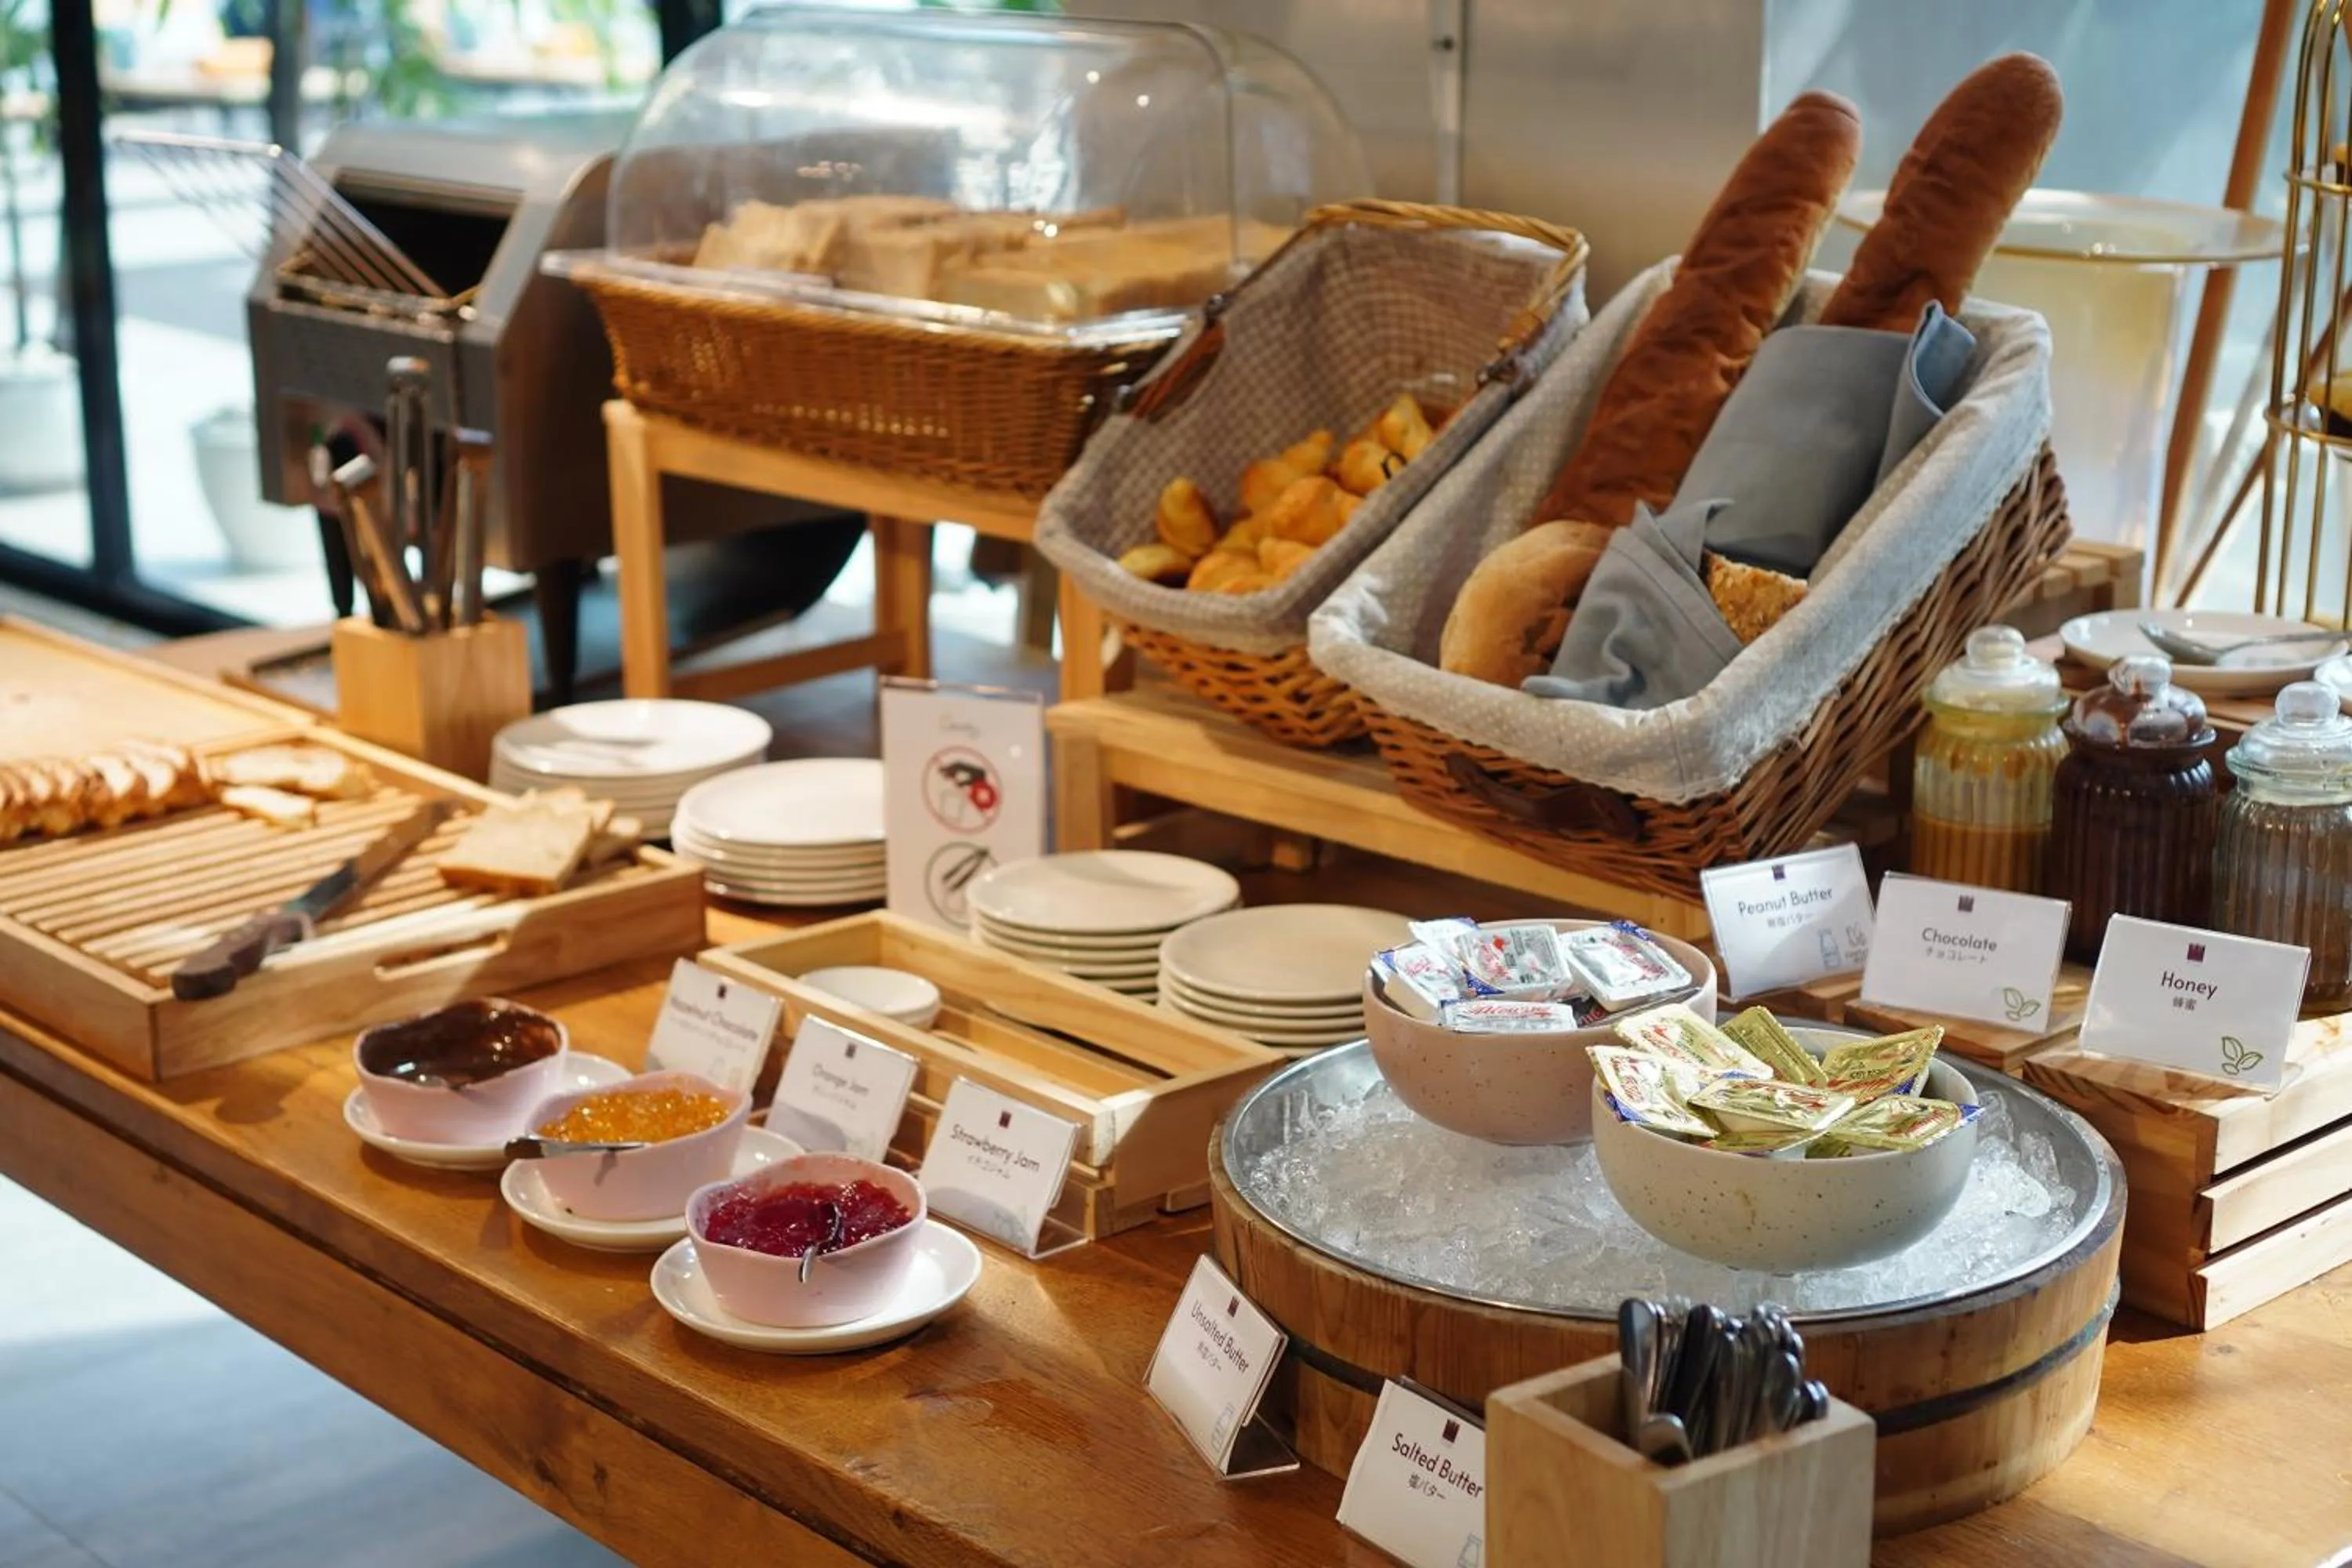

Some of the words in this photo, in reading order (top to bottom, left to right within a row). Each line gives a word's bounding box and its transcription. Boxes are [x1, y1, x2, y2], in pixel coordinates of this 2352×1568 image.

[1737, 896, 1787, 918] Peanut
[1790, 887, 1833, 906] Butter
[1921, 927, 1998, 952] Chocolate
[2161, 969, 2218, 1001] Honey
[949, 1123, 1014, 1165] Strawberry
[1013, 1149, 1040, 1172] Jam
[1191, 1299, 1229, 1348] Unsalted
[1223, 1335, 1250, 1374] Butter
[1392, 1432, 1441, 1473] Salted
[1439, 1458, 1483, 1499] Butter
